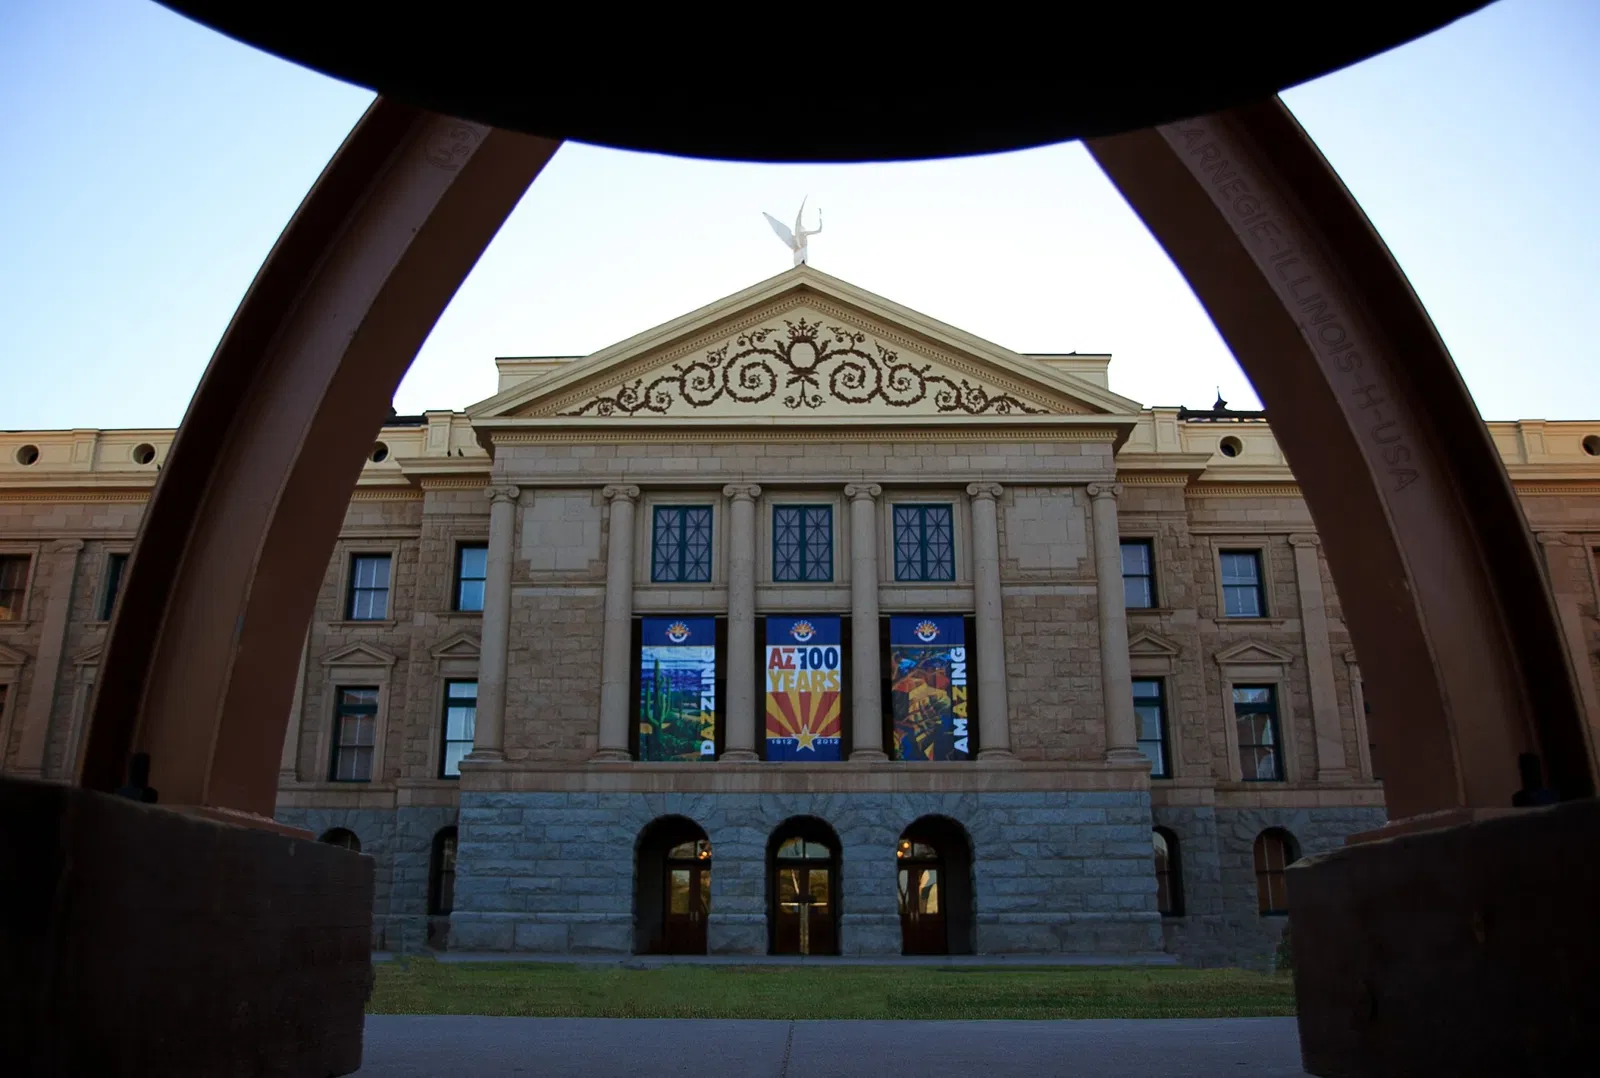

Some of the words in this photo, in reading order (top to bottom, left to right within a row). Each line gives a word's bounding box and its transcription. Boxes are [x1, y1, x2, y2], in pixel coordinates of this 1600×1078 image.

[700, 647, 715, 755] DAZZLING
[768, 670, 840, 693] YEARS
[950, 647, 969, 754] AMAZING
